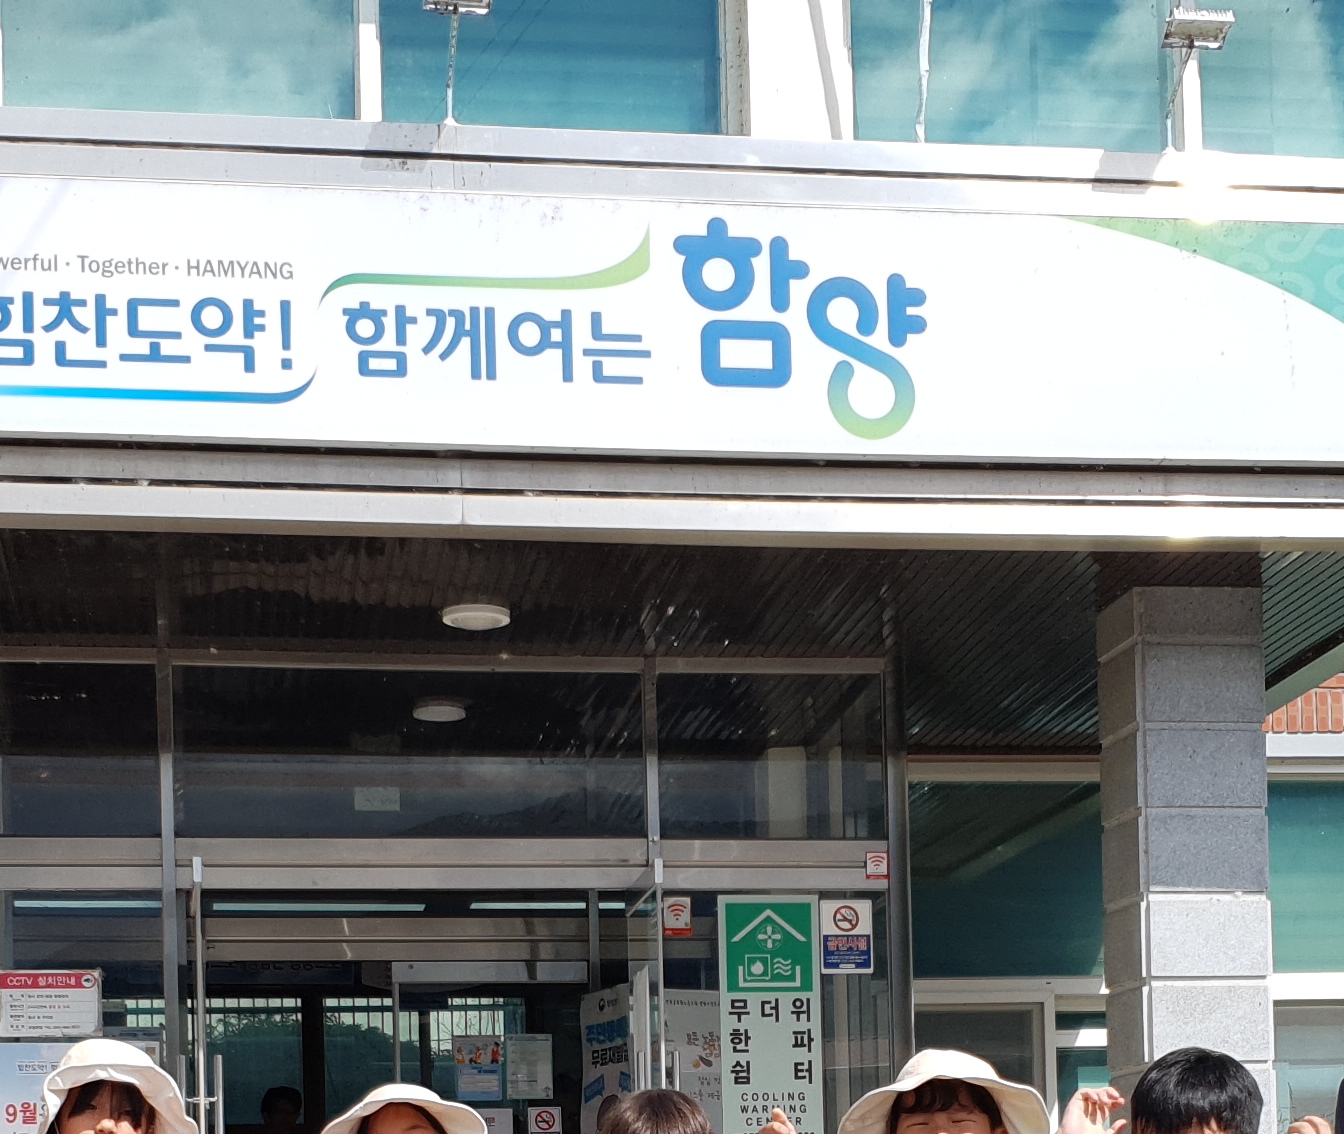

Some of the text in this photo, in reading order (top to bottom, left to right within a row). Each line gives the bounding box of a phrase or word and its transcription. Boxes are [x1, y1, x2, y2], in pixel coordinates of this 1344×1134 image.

[77, 255, 169, 280] Together
[187, 258, 295, 282] HAMYANG
[342, 300, 652, 386] 함께여는
[672, 216, 927, 440] 함양
[7, 976, 76, 986] CCTV 설치안내
[728, 998, 812, 1024] 무더위
[741, 1092, 806, 1102] COOLING
